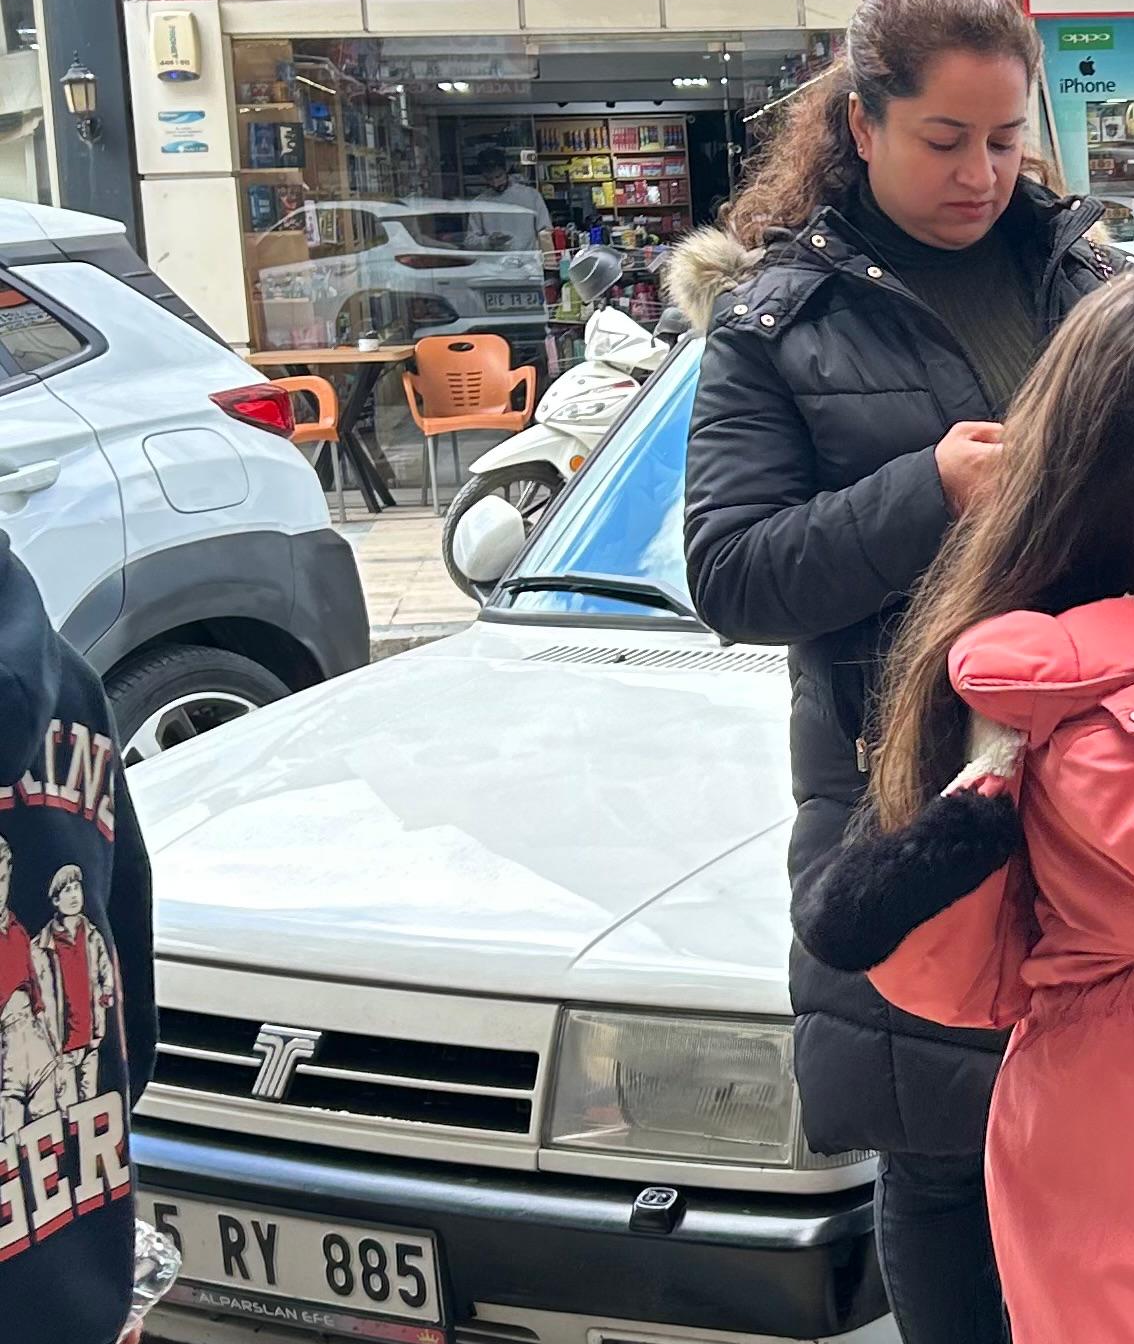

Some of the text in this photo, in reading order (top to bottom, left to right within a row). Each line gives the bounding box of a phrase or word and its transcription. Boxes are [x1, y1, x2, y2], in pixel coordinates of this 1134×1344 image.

[1062, 32, 1110, 44] oppo
[1060, 78, 1116, 94] iPhone
[218, 1214, 277, 1285] RY
[322, 1233, 427, 1308] 885
[199, 1293, 335, 1328] ALPARSLAN EFE
